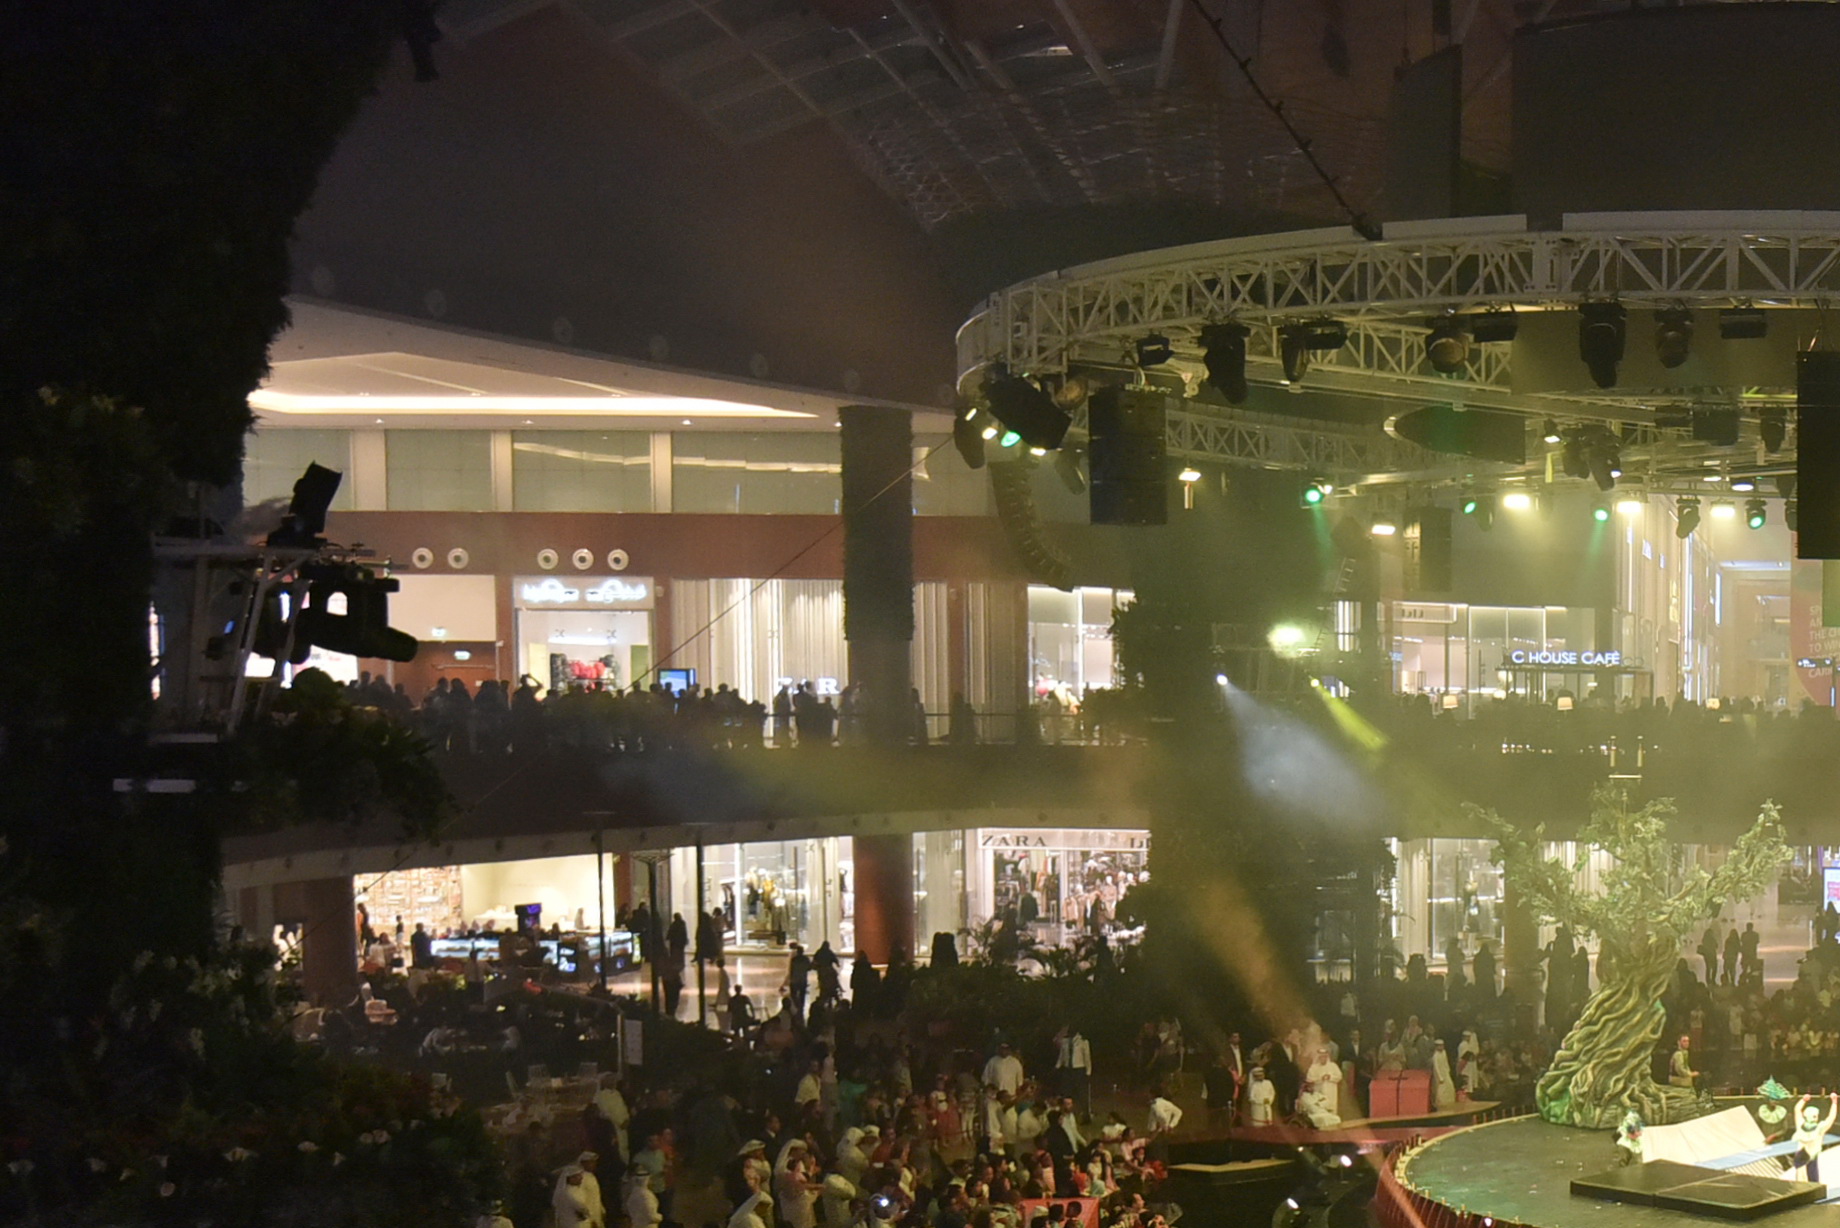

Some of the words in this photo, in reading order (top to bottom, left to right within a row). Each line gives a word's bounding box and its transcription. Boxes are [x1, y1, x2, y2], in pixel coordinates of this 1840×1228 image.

[1809, 642, 1822, 653] TO
[1511, 650, 1525, 664] C
[1528, 651, 1577, 664] HOUSE
[982, 835, 1047, 847] ZARA
